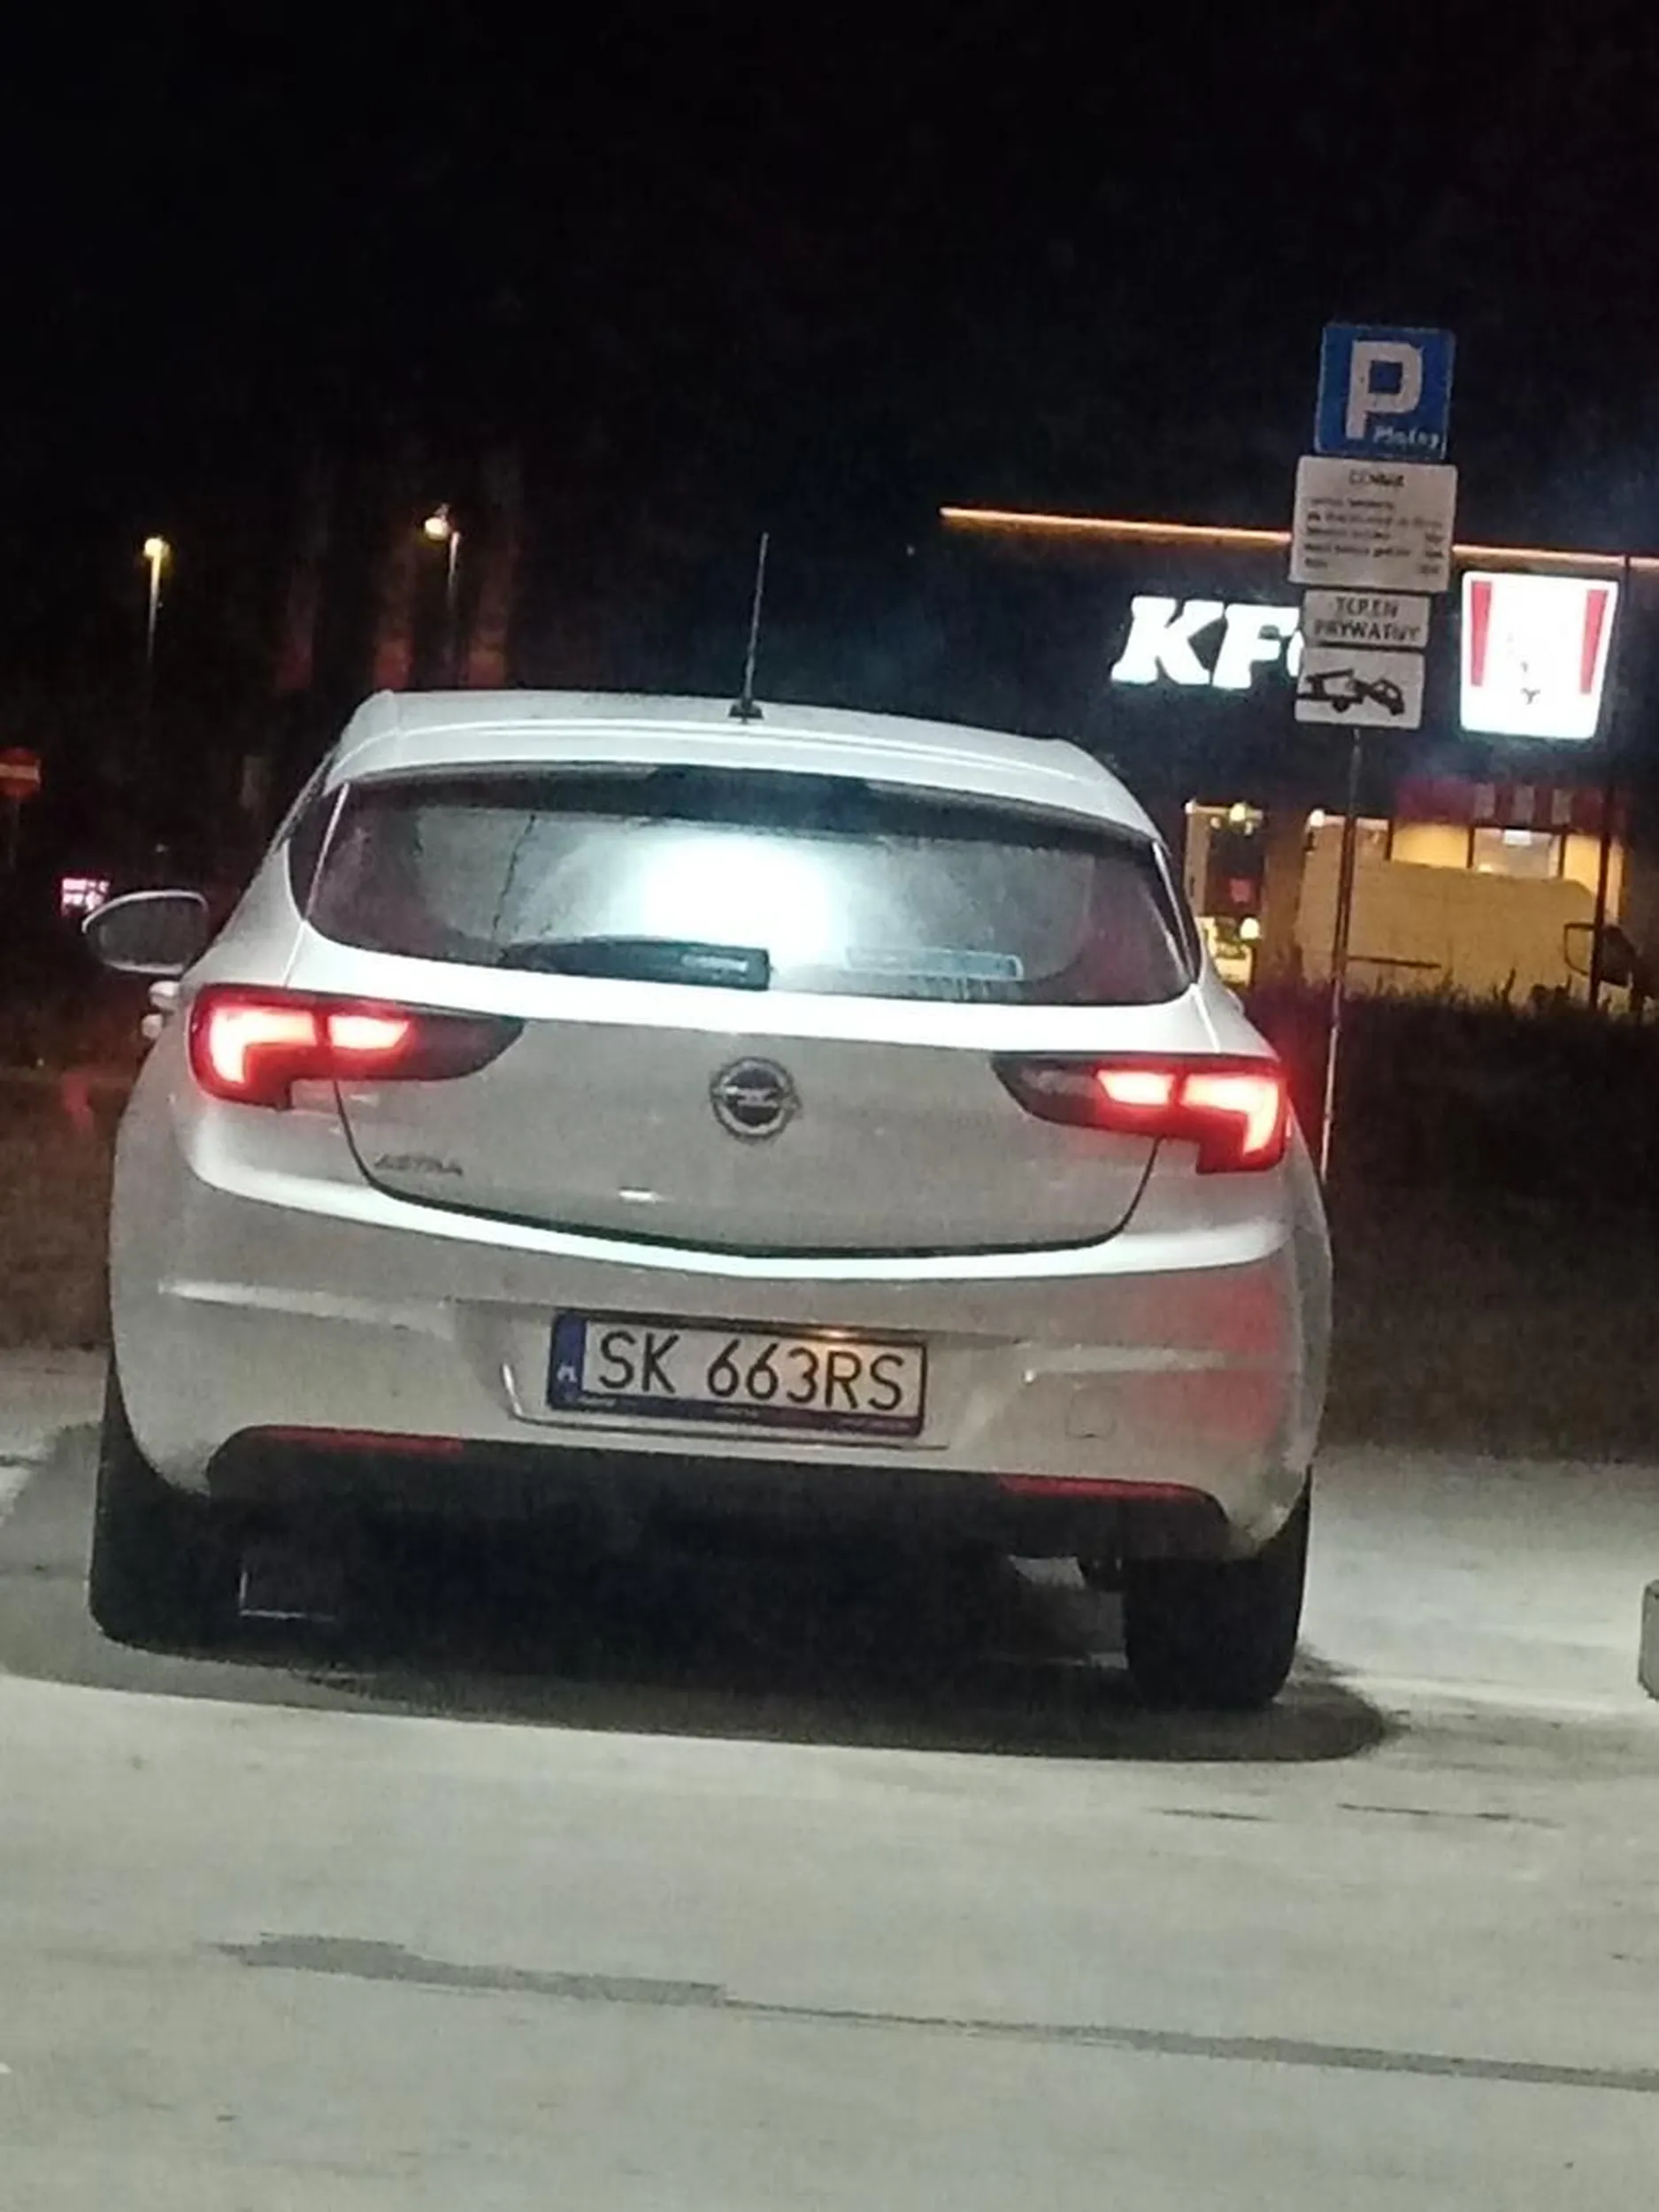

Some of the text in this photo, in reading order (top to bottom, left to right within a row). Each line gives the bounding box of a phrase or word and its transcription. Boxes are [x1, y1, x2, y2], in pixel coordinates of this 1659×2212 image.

[1345, 340, 1424, 440] P
[1110, 595, 1304, 689] KF
[599, 1331, 905, 1410] SK 663RS
